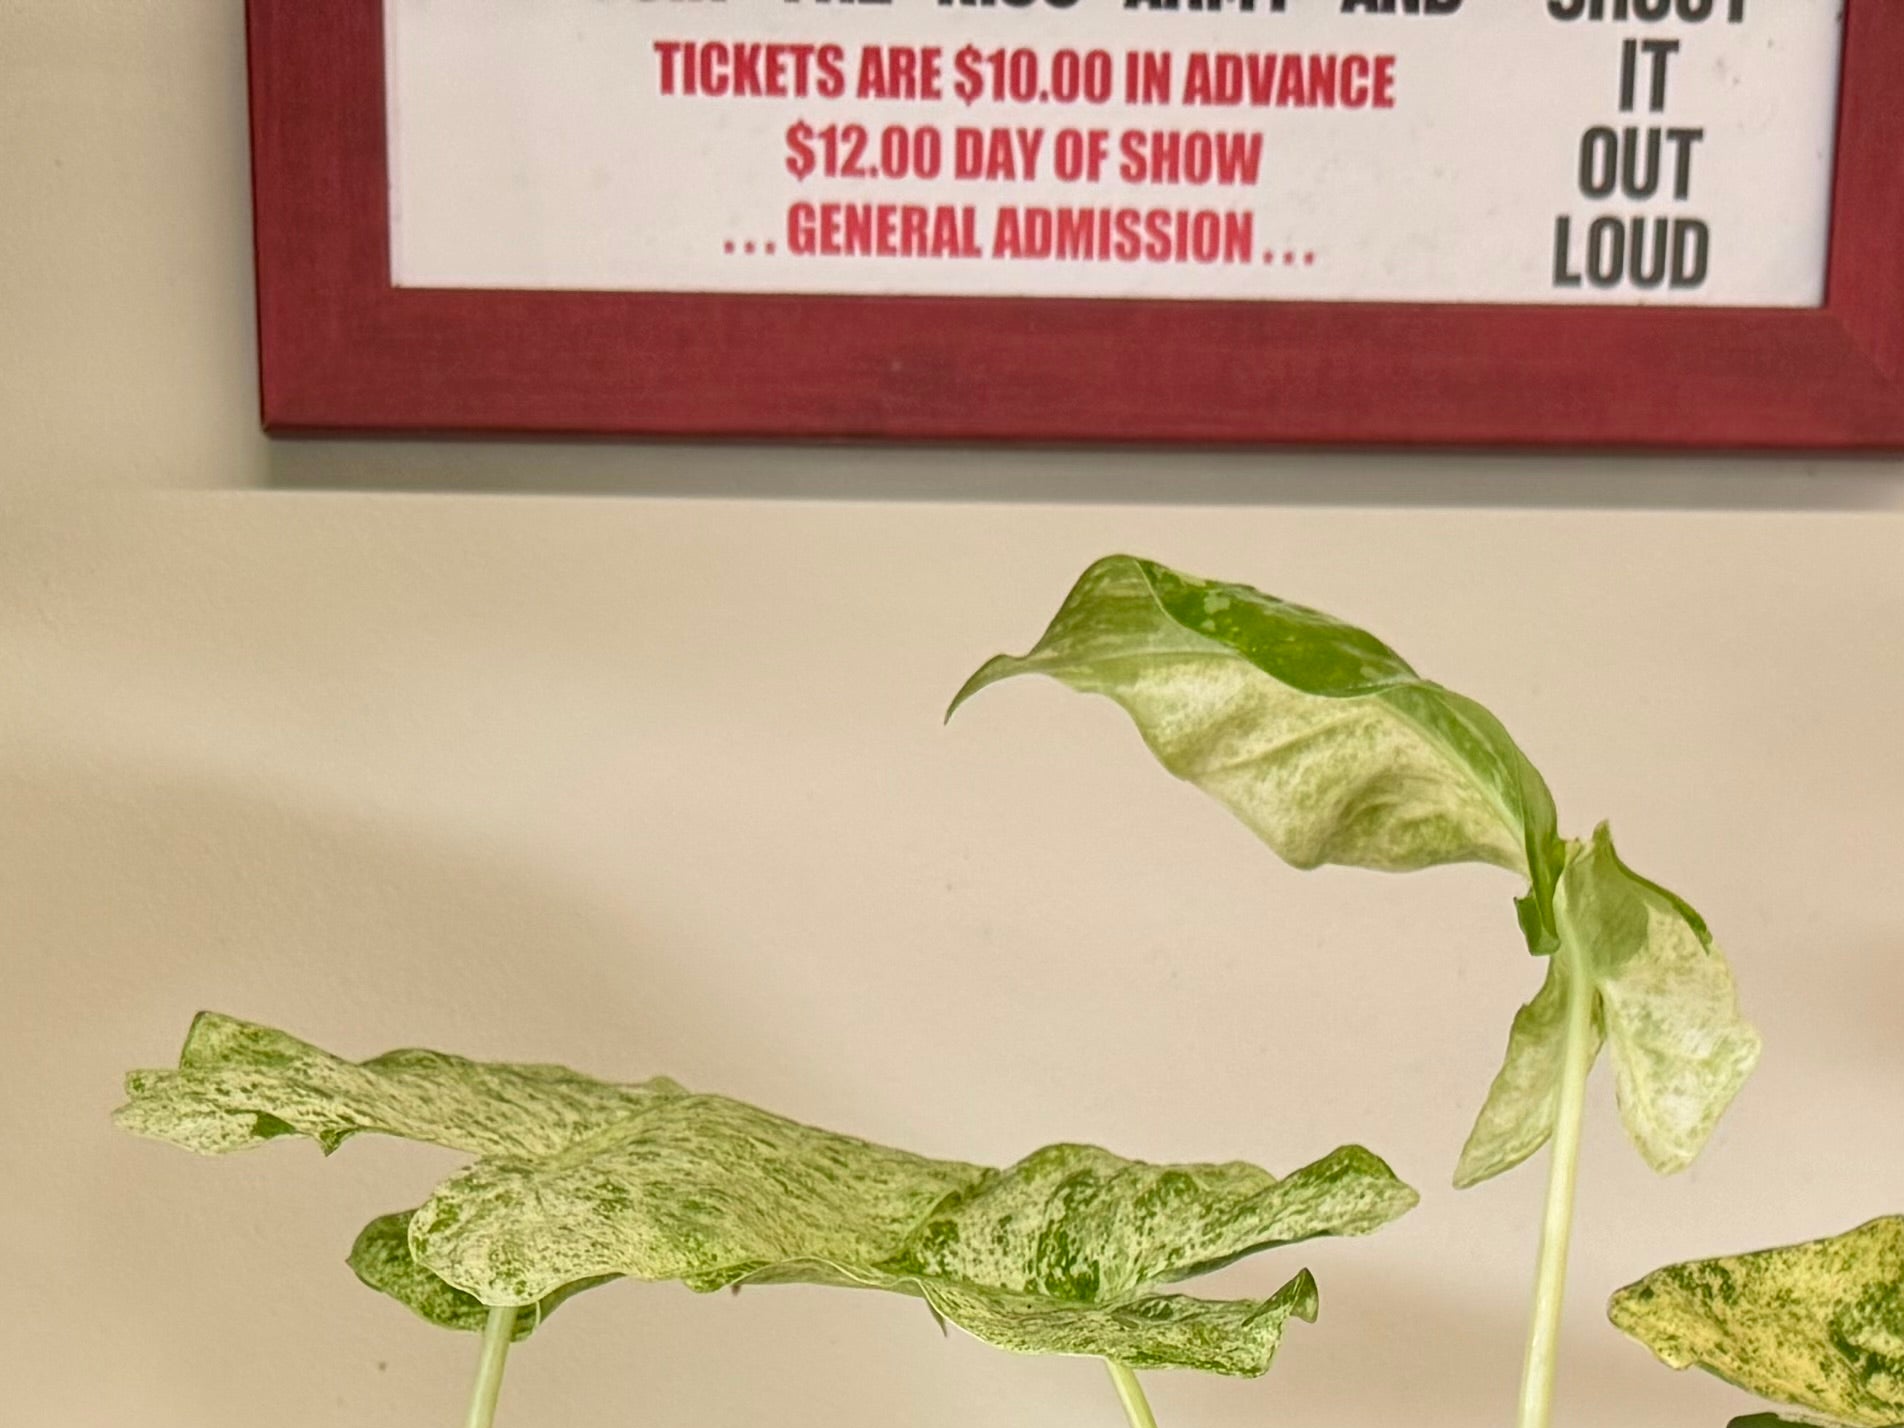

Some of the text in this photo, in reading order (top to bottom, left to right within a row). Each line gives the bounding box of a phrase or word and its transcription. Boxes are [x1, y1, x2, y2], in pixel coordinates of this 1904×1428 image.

[653, 40, 1396, 108] TICKETS ARE $10.00 IN ADVANCE
[1618, 38, 1680, 112] IT
[784, 121, 1263, 186] $12.00 DAY OF SHOW
[1578, 126, 1703, 200] OUT
[1552, 214, 1710, 289] LOUD
